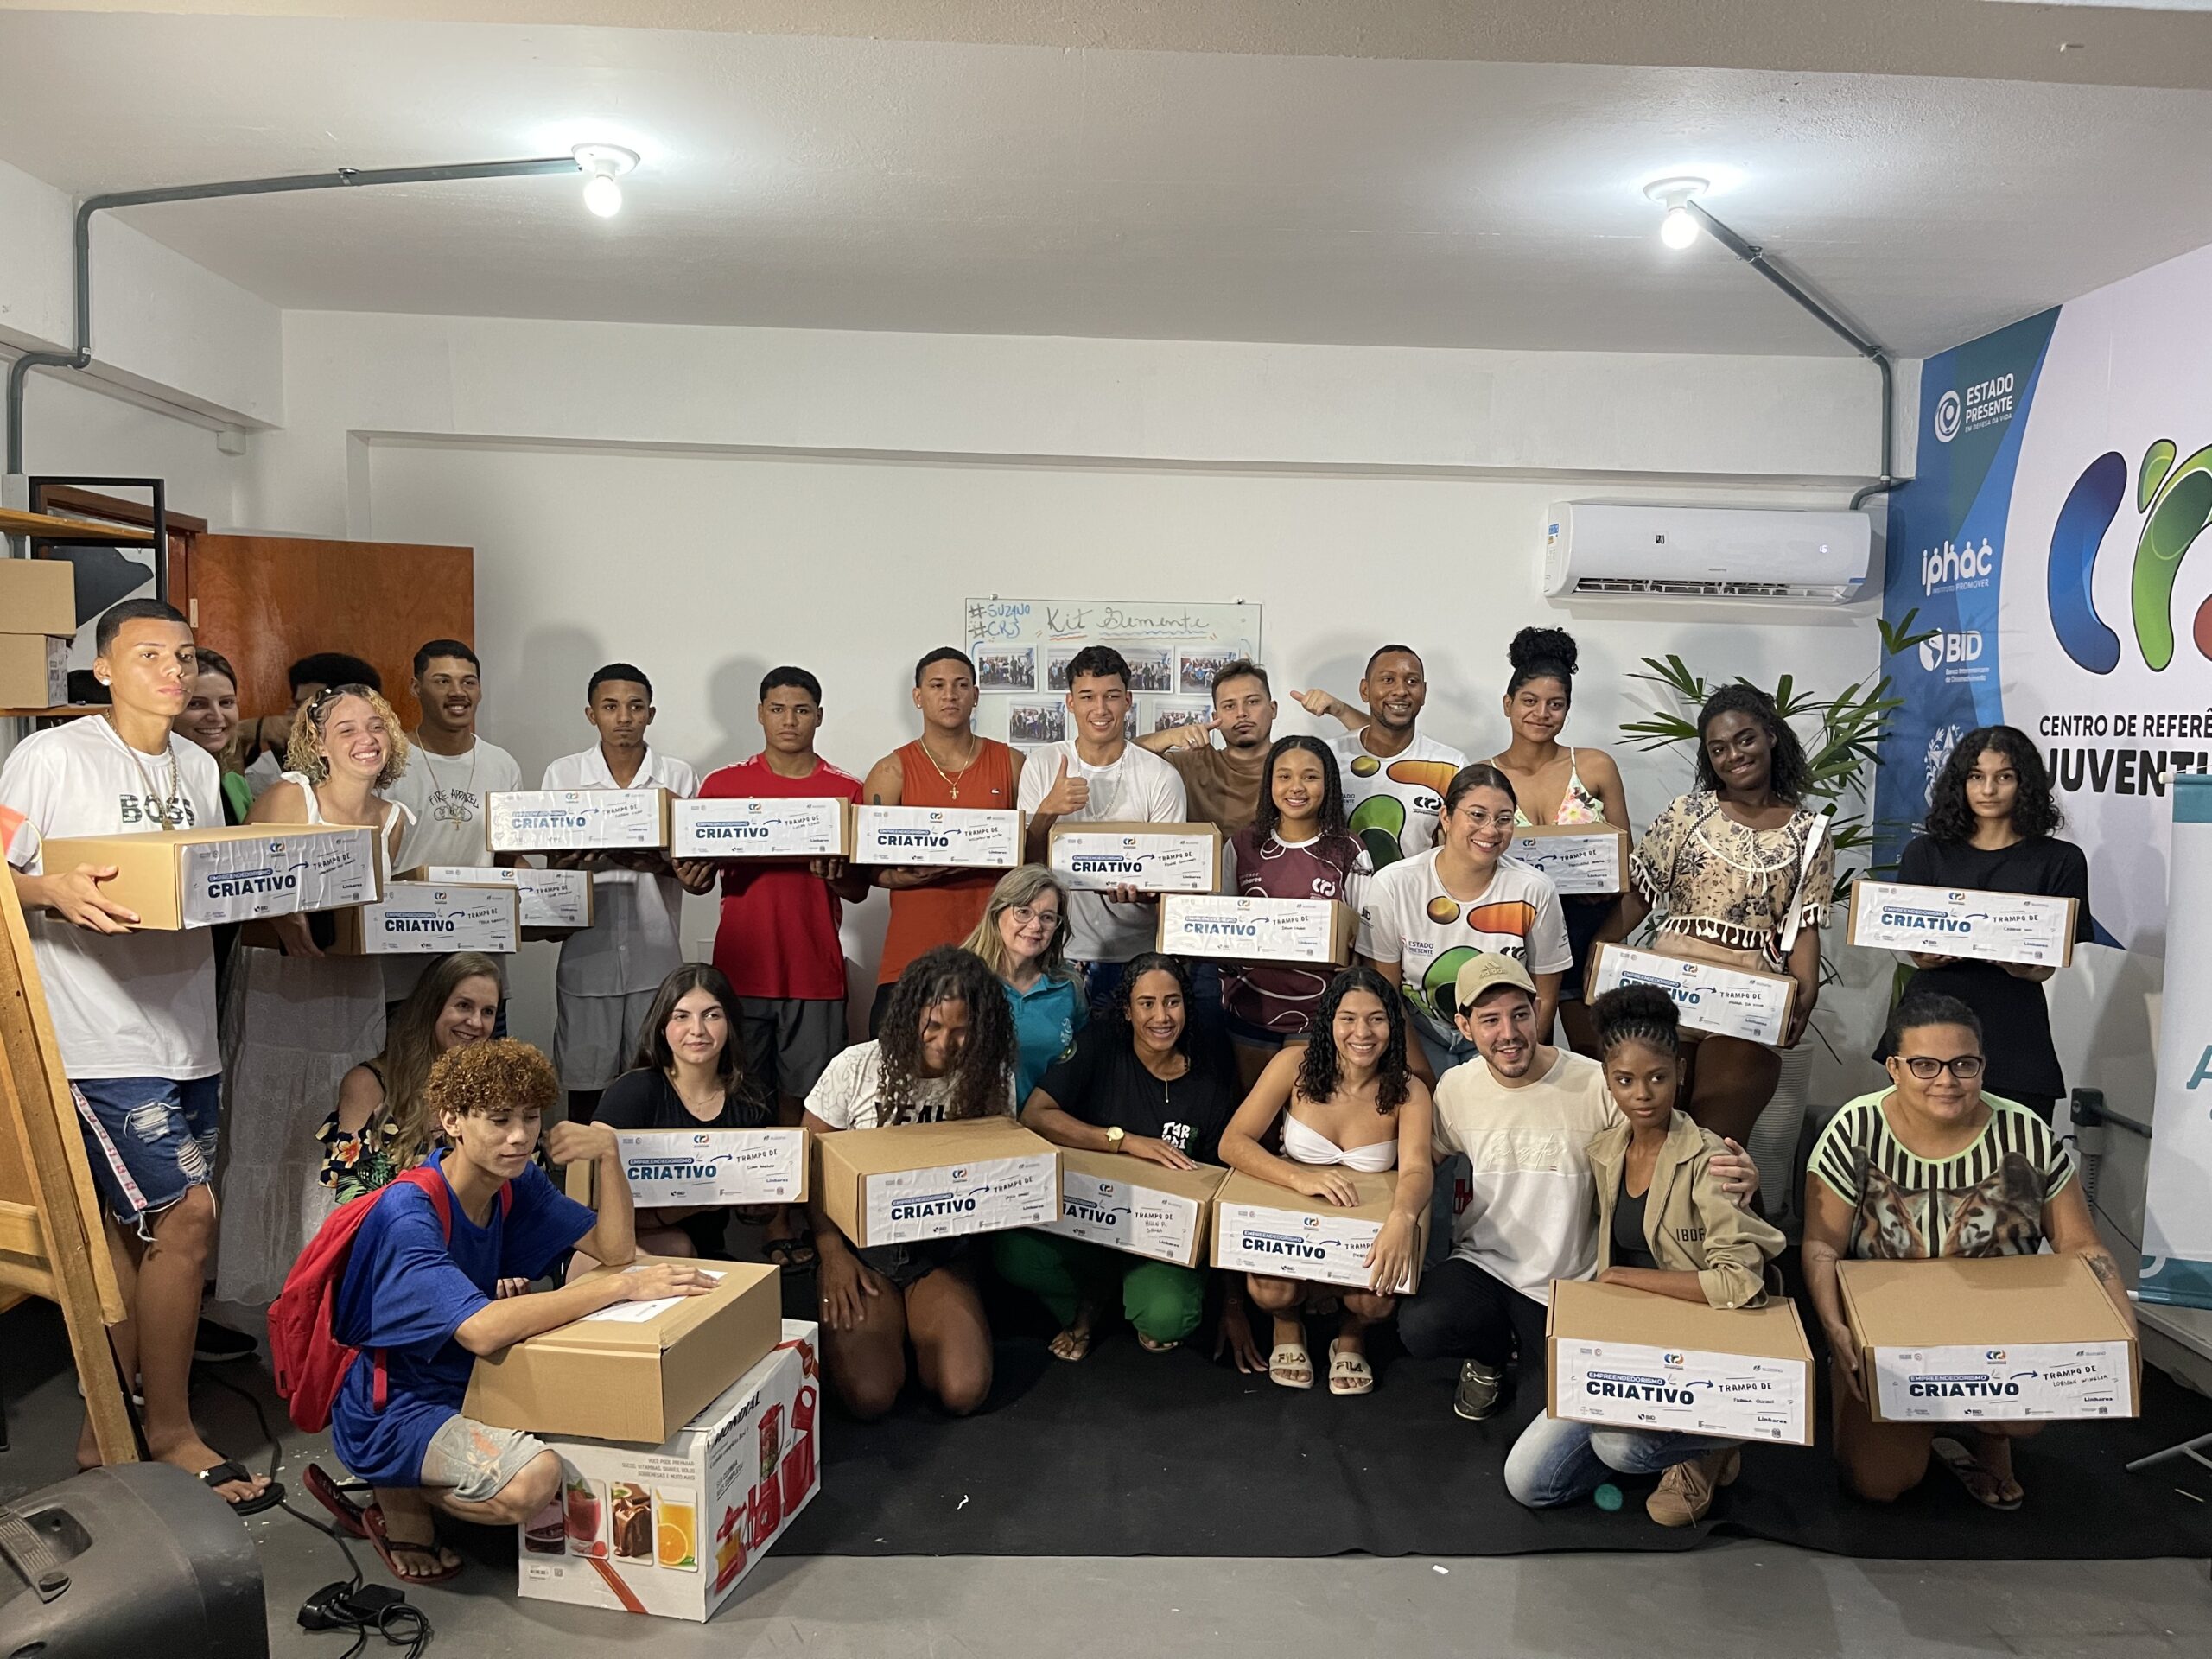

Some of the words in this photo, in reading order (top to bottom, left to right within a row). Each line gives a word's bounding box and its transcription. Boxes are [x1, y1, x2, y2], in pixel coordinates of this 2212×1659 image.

[1967, 372, 2014, 406] ESTADO
[1966, 395, 2013, 423] PRESENTE
[1955, 579, 1989, 592] PROMOVER
[1046, 607, 1093, 632] Kit
[1946, 631, 1983, 663] BID
[2039, 715, 2108, 737] CENTRO
[2113, 715, 2137, 737] DE
[119, 794, 195, 826] BOSS
[512, 817, 586, 829] CRIATIVO
[785, 817, 810, 826] TRAMPO
[696, 827, 769, 838] CRIATIVO
[964, 828, 989, 837] TRAMPO
[878, 835, 949, 847] CRIATIVO
[314, 855, 340, 871] TRAMPO
[342, 853, 351, 861] DE
[1560, 852, 1587, 861] TRAMPO
[1071, 861, 1142, 873] CRIATIVO
[208, 875, 296, 899] CRIATIVO
[468, 910, 490, 919] TRAMPO
[385, 919, 454, 932] CRIATIVO
[1184, 923, 1256, 936] CRIATIVO
[1881, 913, 1971, 933] CRIATIVO
[1408, 941, 1433, 950] ESTADO
[736, 1153, 766, 1163] TRAMPO
[627, 1166, 717, 1180] CRIATIVO
[994, 1180, 1022, 1193] TRAMPO
[891, 1198, 976, 1221] CRIATIVO
[1063, 1203, 1116, 1225] IATIVO
[1242, 1238, 1325, 1259] CRIATIVO
[1278, 1352, 1306, 1363] FILA
[1336, 1361, 1363, 1372] FILA
[1589, 1372, 1663, 1385] EMPREENDEDORISMO
[2043, 1369, 2082, 1381] TRAMPO
[1586, 1382, 1694, 1405] CRIATIVO
[1719, 1383, 1757, 1392] TRAMPO
[1910, 1382, 2019, 1397] CRIATIVO
[711, 1390, 760, 1450] MONDIAL
